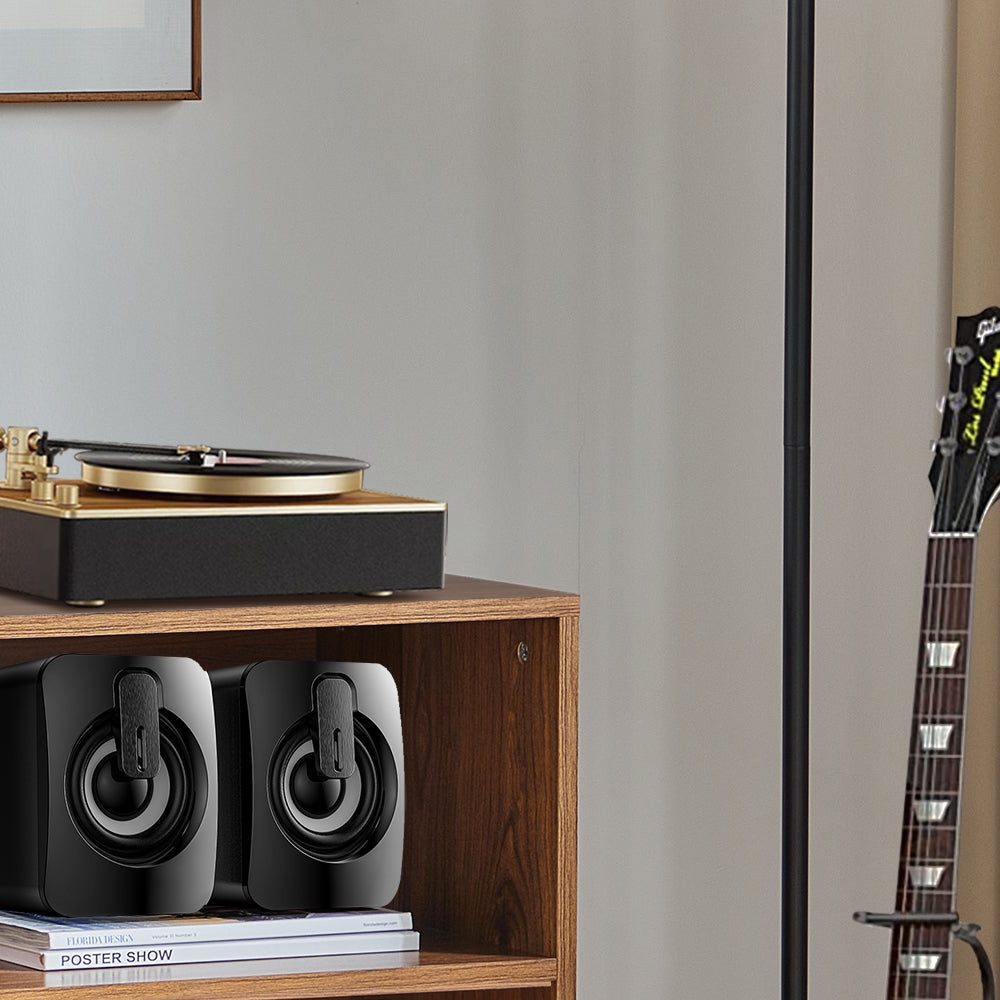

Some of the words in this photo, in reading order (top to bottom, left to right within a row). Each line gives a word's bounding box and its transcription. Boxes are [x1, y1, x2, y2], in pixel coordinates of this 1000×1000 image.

[66, 934, 103, 946] FLORIDA
[104, 933, 134, 944] DESIGN
[61, 951, 122, 967] POSTER
[126, 949, 173, 964] SHOW
